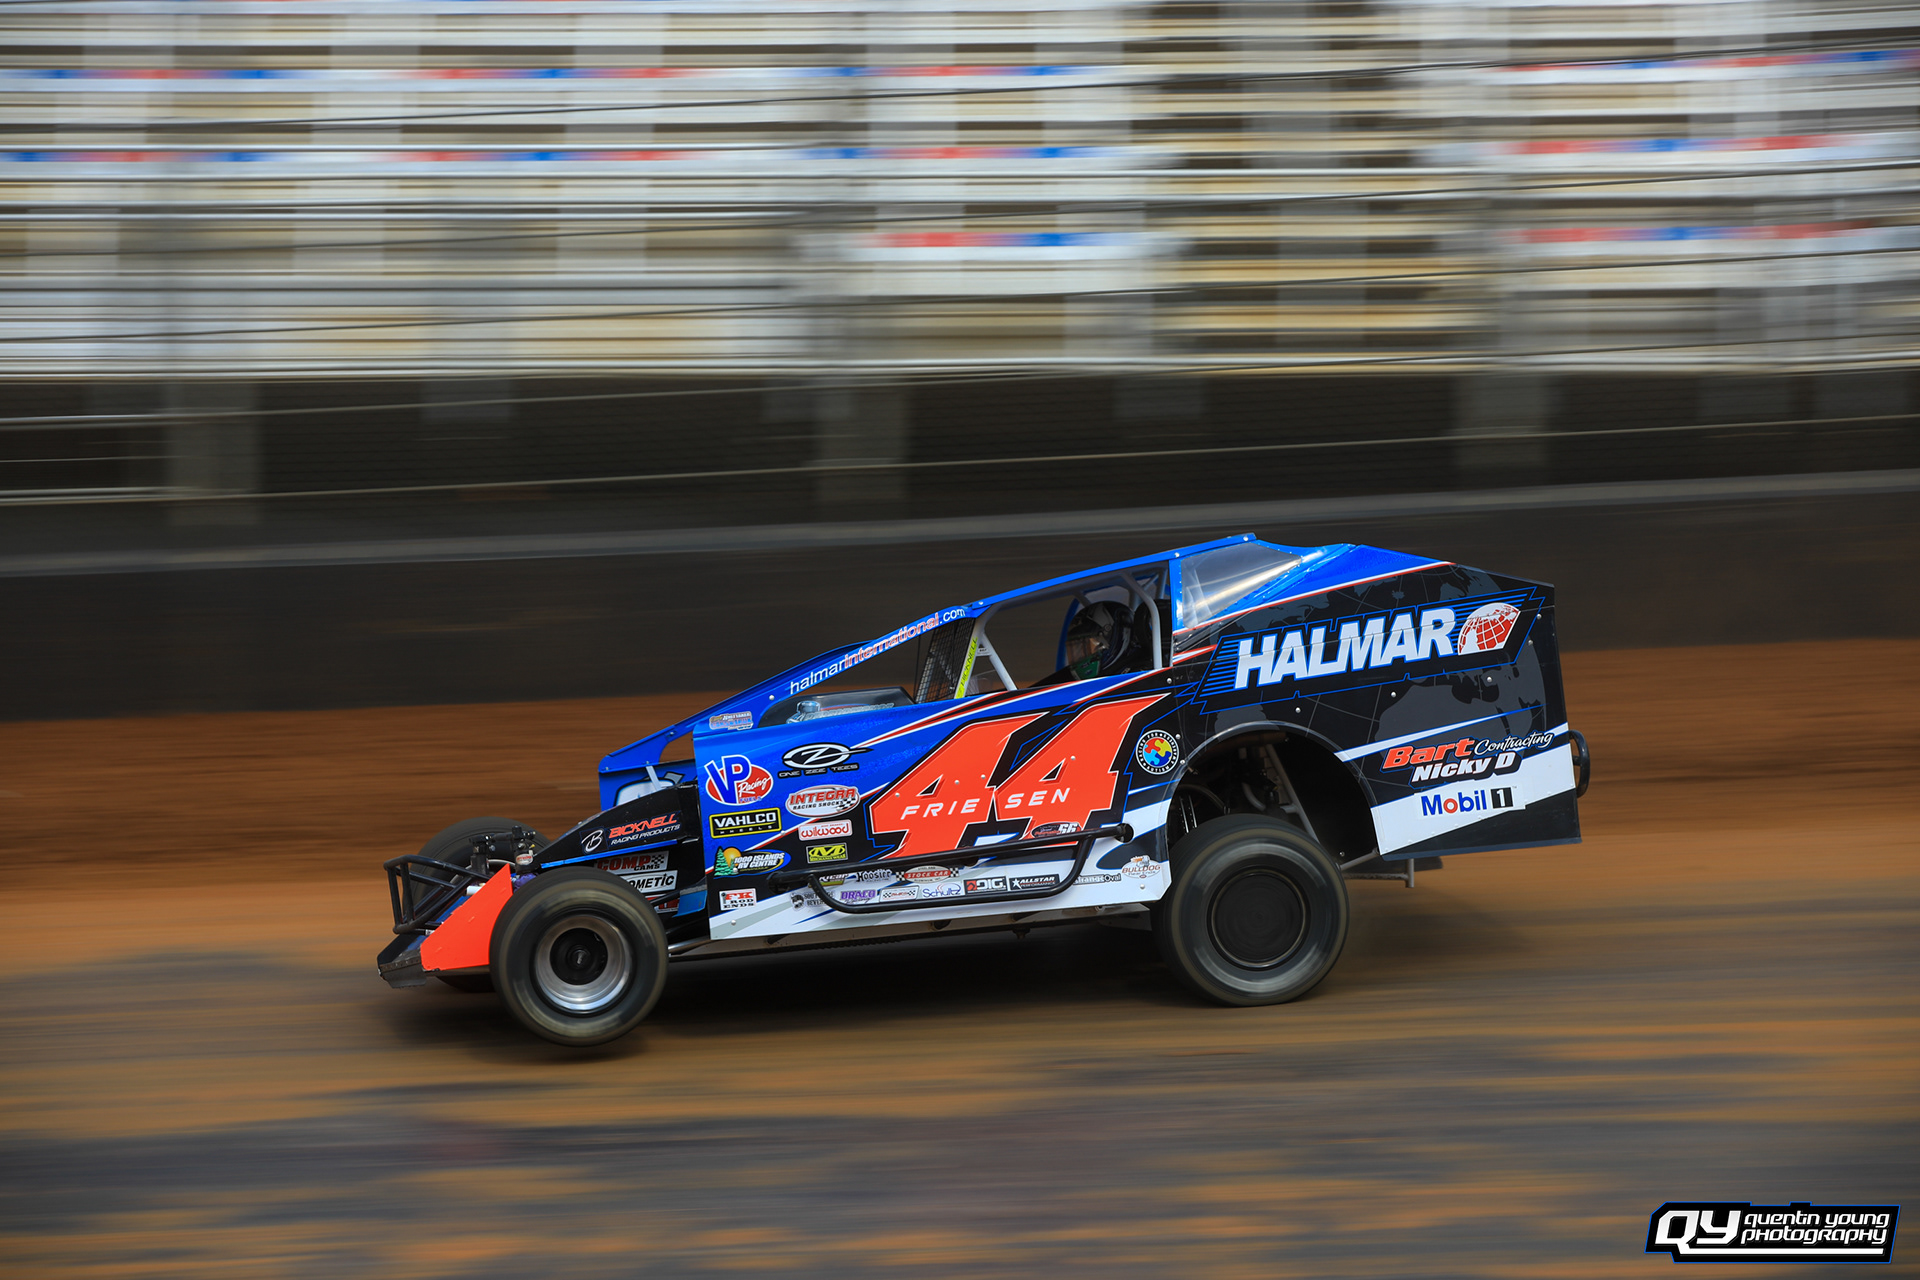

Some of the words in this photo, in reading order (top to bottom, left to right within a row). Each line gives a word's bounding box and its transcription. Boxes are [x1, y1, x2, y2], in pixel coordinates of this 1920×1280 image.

[790, 607, 966, 695] halmarinternational.com
[1233, 607, 1456, 690] HALMAR
[1382, 738, 1475, 769] Bart
[1474, 731, 1554, 755] Contracting
[779, 770, 800, 778] ONE
[805, 767, 827, 775] ZEE
[831, 764, 858, 772] TEES
[1411, 757, 1493, 783] Nicky
[1494, 752, 1517, 770] D
[704, 754, 751, 805] VP
[870, 692, 1172, 860] 44
[738, 776, 771, 797] Racing
[789, 788, 857, 805] INTEGRA
[900, 787, 1071, 820] FRIESEN
[1421, 789, 1487, 816] Mobil
[793, 802, 817, 810] RACING
[818, 800, 844, 808] SHOCKS
[609, 813, 678, 839] BICKNELL
[714, 812, 777, 828] VAHLCO
[610, 833, 640, 846] RACING
[638, 823, 681, 839] PRODUCTS
[800, 822, 850, 838] wilwood
[597, 855, 651, 871] COMP
[734, 856, 753, 864] 1000
[753, 852, 785, 861] ISLANDS
[738, 861, 750, 869] RV
[749, 859, 777, 868] CENTRE
[633, 863, 661, 871] CAMS
[1121, 864, 1161, 874] BULLDOG
[856, 870, 892, 883] Hoosier
[1020, 876, 1055, 884] ALLSTAR
[725, 891, 753, 900] FK
[840, 889, 876, 900] DRACO
[922, 884, 962, 898] Schultz
